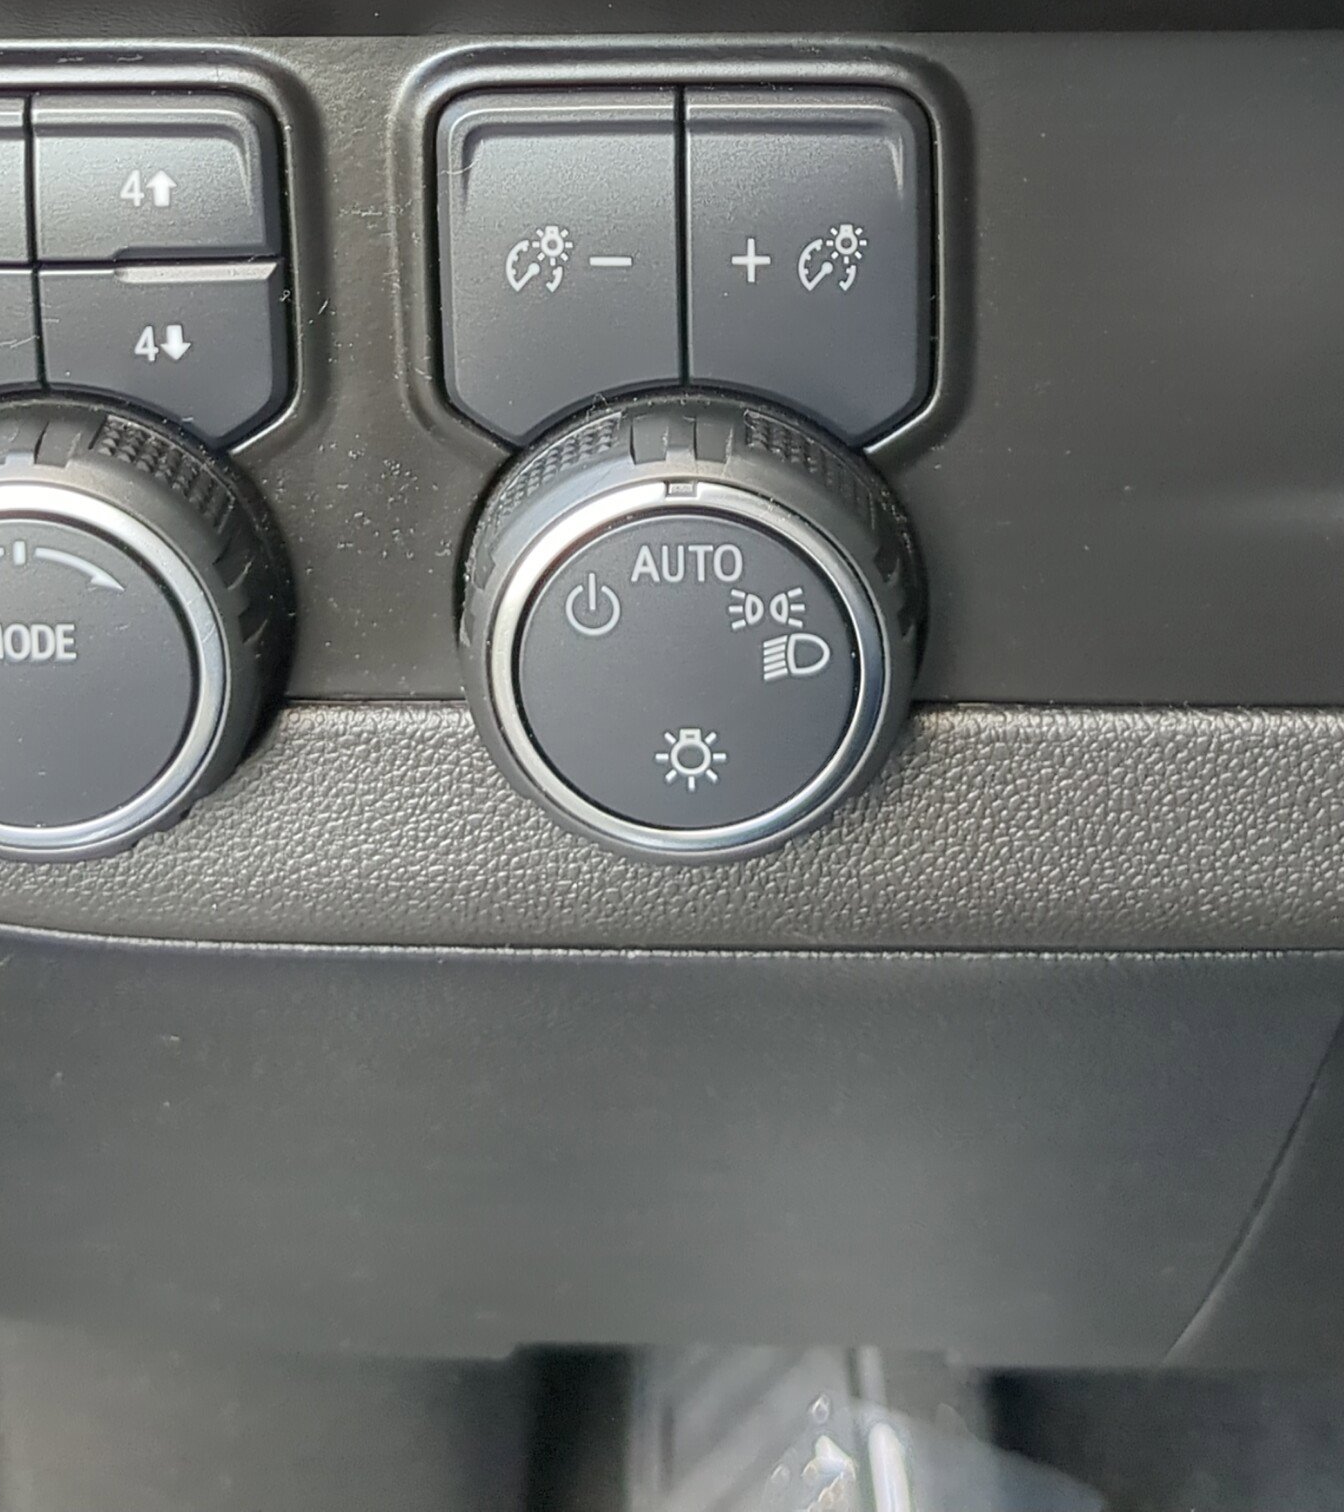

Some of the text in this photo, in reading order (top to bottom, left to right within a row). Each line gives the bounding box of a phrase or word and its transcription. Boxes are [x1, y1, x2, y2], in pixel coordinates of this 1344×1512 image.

[120, 171, 146, 207] 4
[134, 325, 160, 362] 4
[631, 544, 743, 583] AUTO
